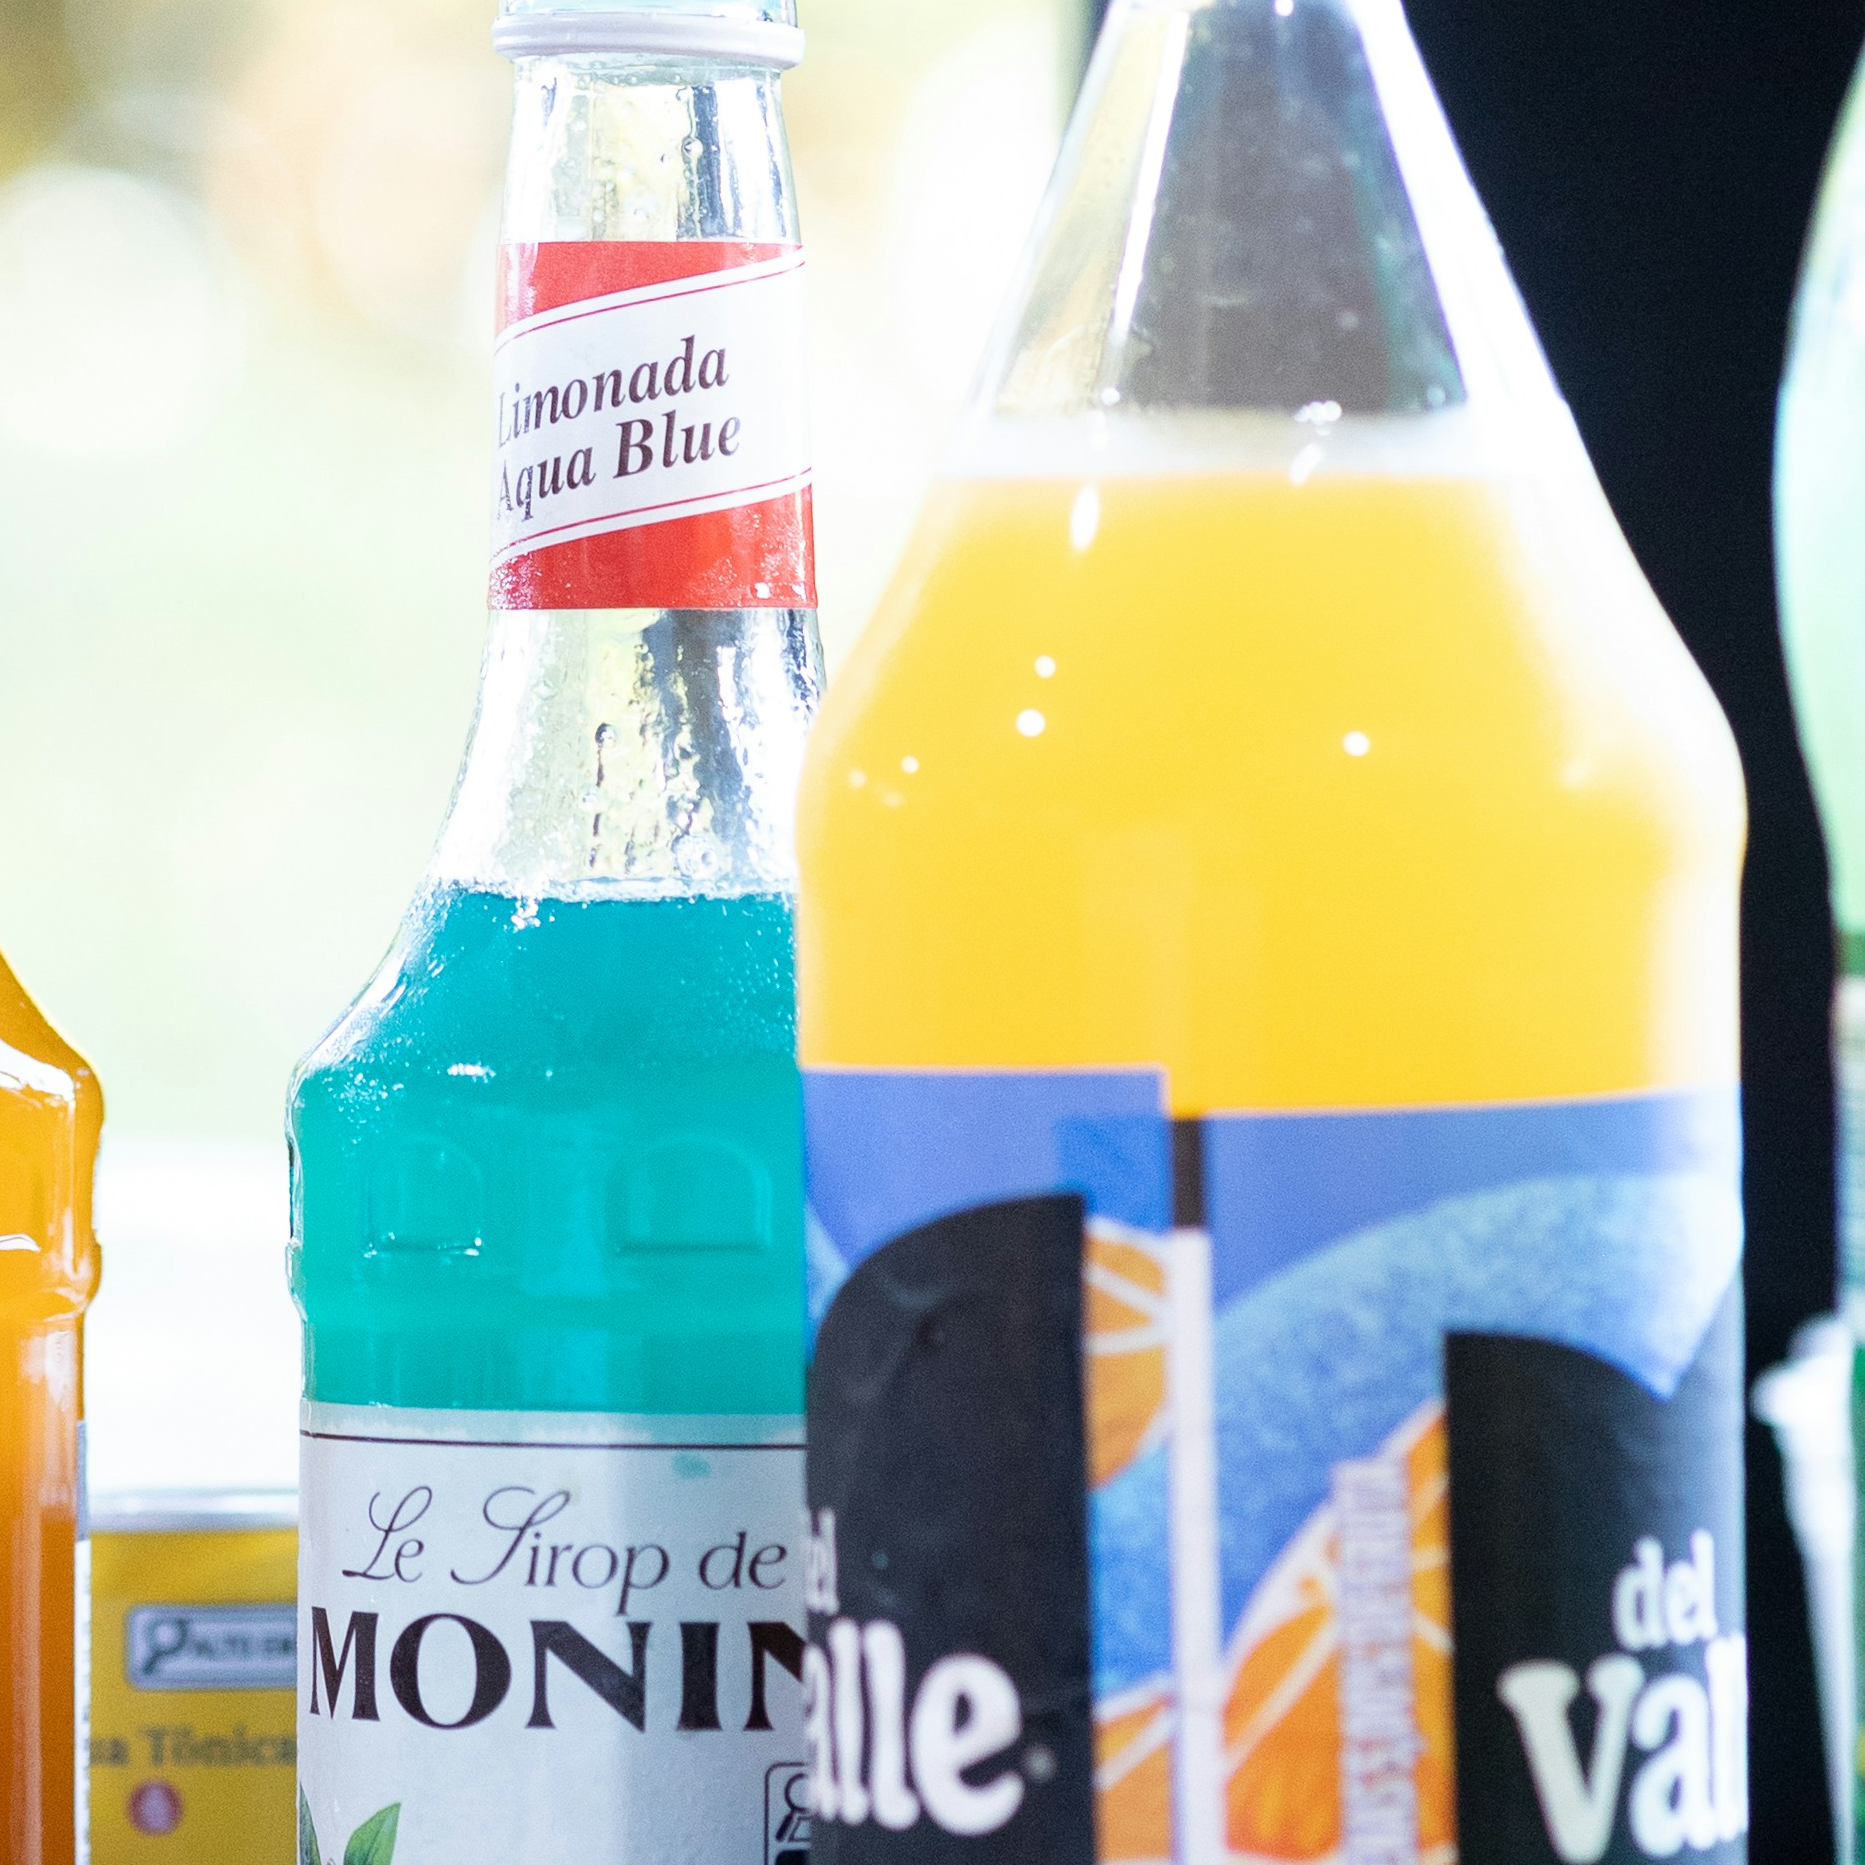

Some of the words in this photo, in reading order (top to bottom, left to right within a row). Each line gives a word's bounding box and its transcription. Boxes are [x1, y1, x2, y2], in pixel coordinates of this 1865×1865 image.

[497, 335, 730, 448] Limonada
[496, 446, 597, 522] Aqua
[613, 409, 742, 479] Blue
[341, 1485, 433, 1584] Le
[449, 1485, 671, 1617] Sirop
[698, 1530, 788, 1591] de
[1613, 1529, 1718, 1651] del
[309, 1605, 808, 1735] MONIN
[802, 1615, 1025, 1837] alle
